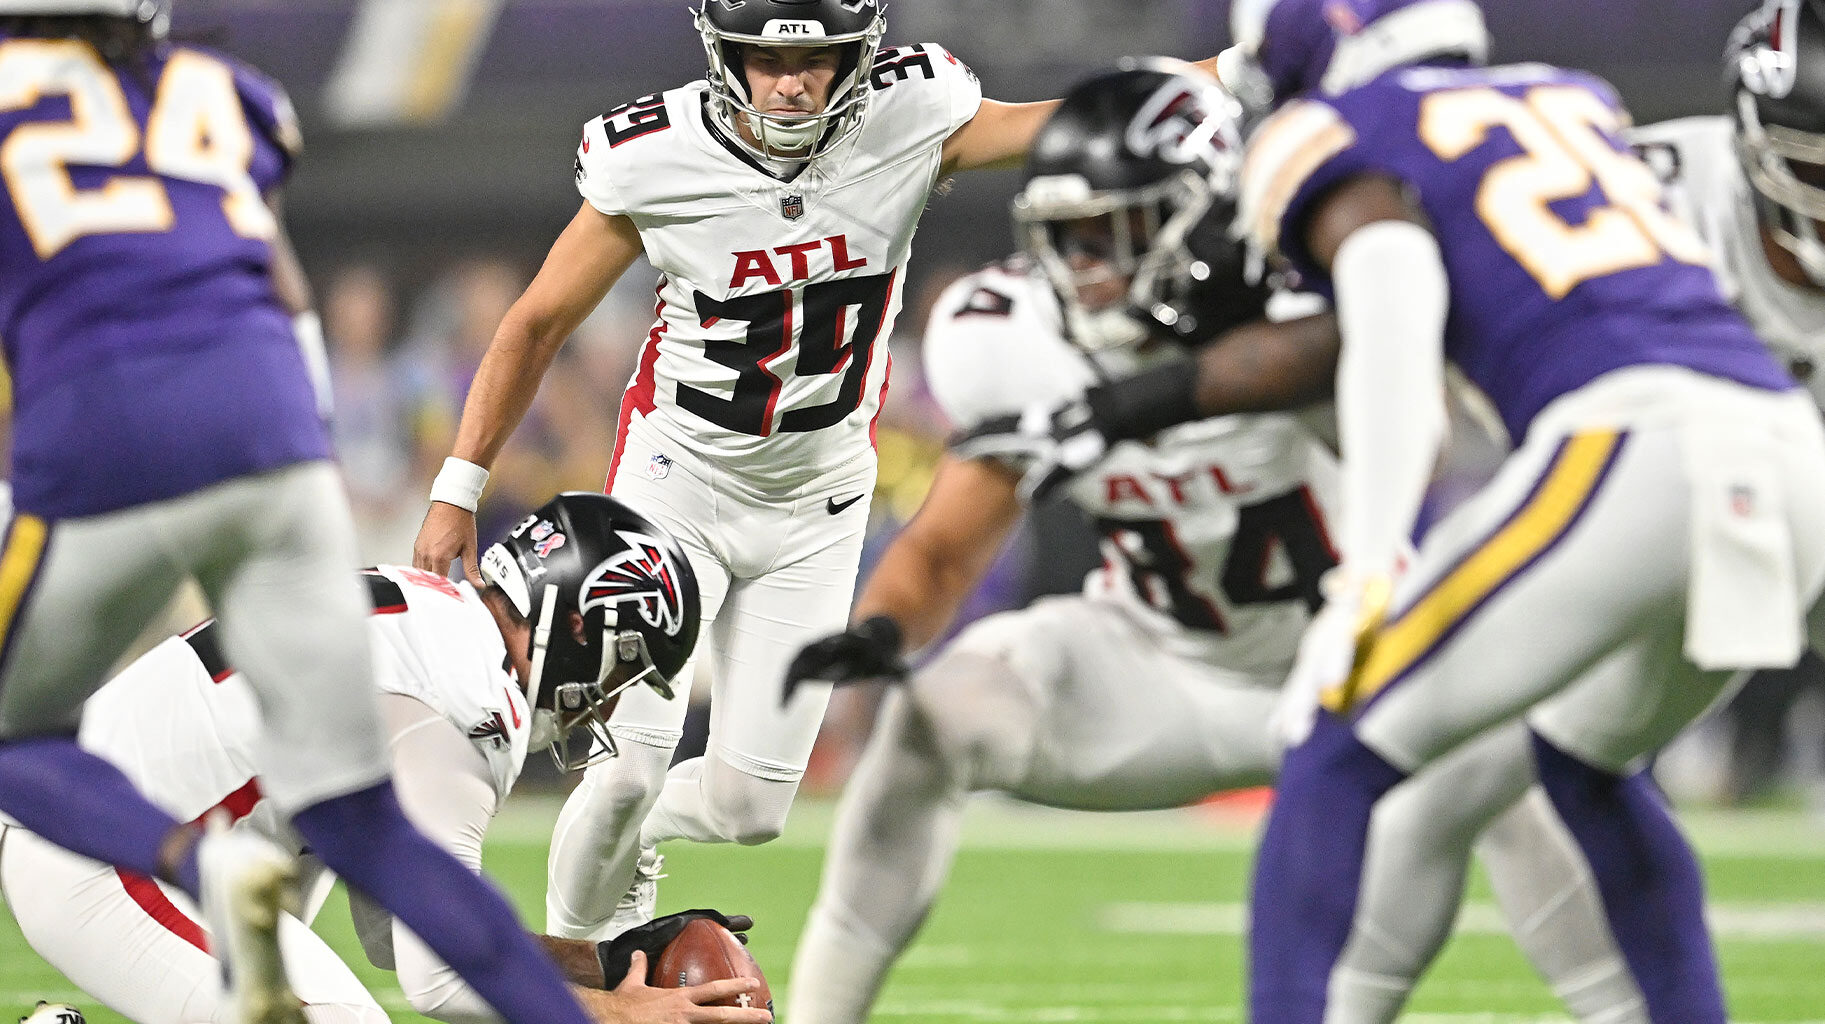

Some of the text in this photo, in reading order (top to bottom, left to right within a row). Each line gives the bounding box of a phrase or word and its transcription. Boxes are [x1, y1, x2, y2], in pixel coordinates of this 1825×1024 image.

[778, 23, 810, 34] ATL
[0, 37, 276, 260] 24
[784, 204, 802, 217] NFL
[728, 234, 867, 289] ATL
[675, 266, 898, 438] 39
[1104, 461, 1260, 505] ATL
